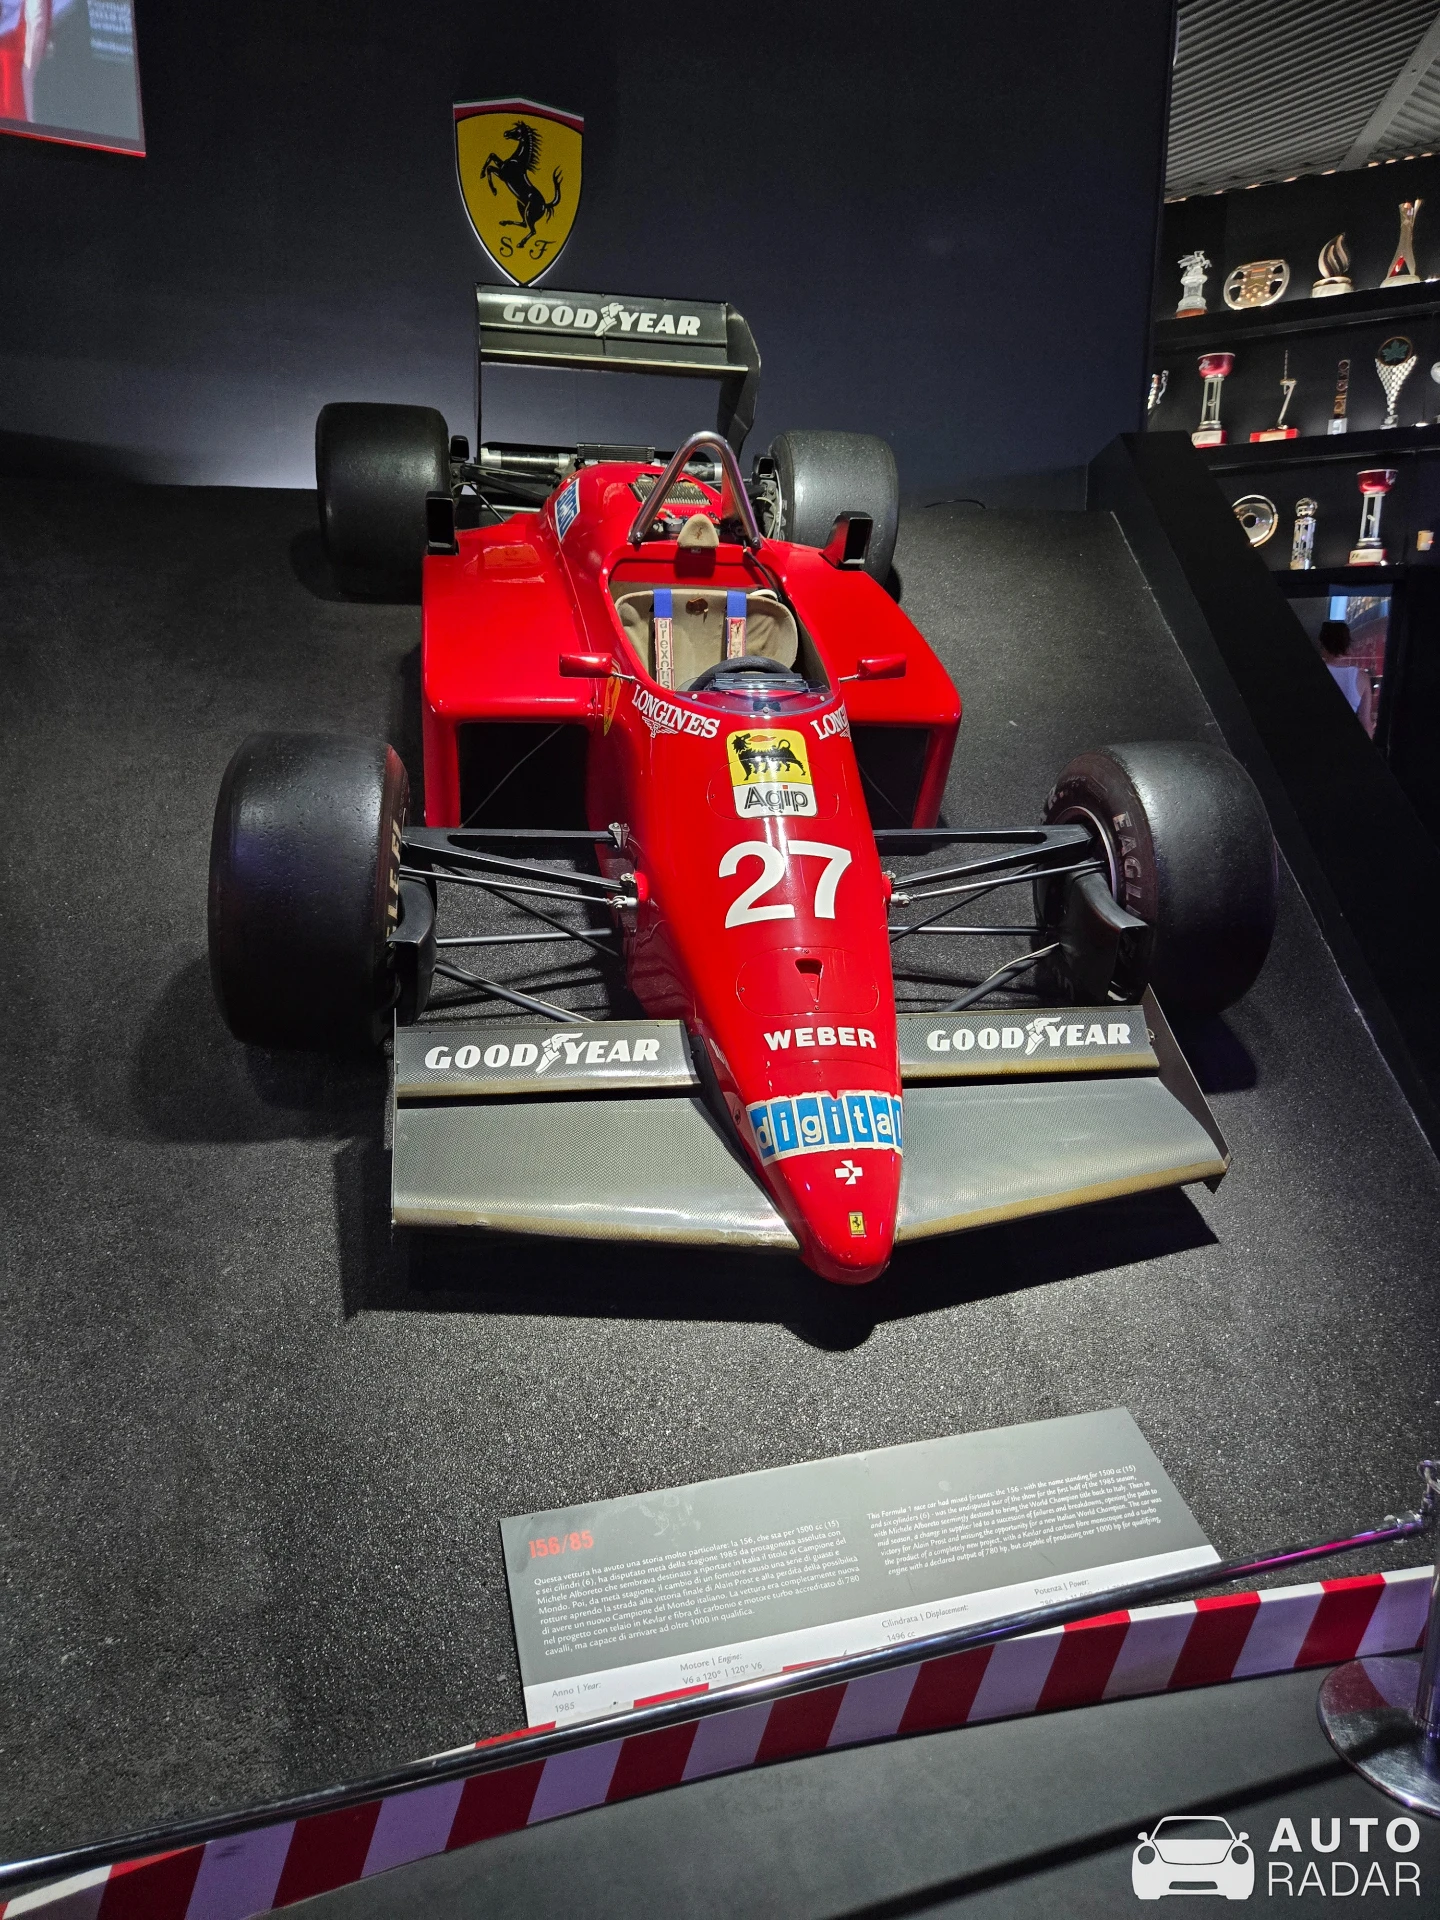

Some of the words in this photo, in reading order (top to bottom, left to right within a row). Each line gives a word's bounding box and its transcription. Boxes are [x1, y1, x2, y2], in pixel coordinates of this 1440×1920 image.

[500, 237, 515, 258] S
[529, 239, 556, 260] F
[632, 684, 720, 739] LONGINES
[743, 784, 810, 814] Agip
[718, 839, 852, 929] 27
[1113, 811, 1143, 915] EAGL
[763, 1027, 877, 1051] WEBER
[755, 1103, 901, 1150] digital
[529, 1530, 594, 1559] 156/85
[533, 1575, 563, 1586] Questa
[563, 1570, 591, 1580] vettura
[591, 1567, 602, 1575] ha
[603, 1563, 625, 1573] avuto
[626, 1560, 641, 1568] una
[641, 1555, 664, 1565] storia
[664, 1551, 687, 1561] molto
[688, 1543, 730, 1558] particolare:
[739, 1536, 756, 1545] 156,
[756, 1534, 769, 1542] che
[770, 1532, 782, 1540] sta
[783, 1529, 795, 1539] per
[796, 1524, 814, 1534] 1500
[824, 1519, 840, 1530] (15)
[541, 1585, 553, 1594] sei
[553, 1580, 581, 1592] cilindri
[581, 1577, 597, 1588] (6),
[597, 1575, 609, 1583] ha
[609, 1569, 646, 1581] disputato
[647, 1564, 667, 1574] metà
[667, 1560, 686, 1570] della
[687, 1555, 718, 1566] stagione
[719, 1549, 738, 1559] 1985
[750, 1539, 796, 1555] protagonista
[797, 1533, 827, 1544] assoluta
[827, 1530, 841, 1538] con
[537, 1593, 567, 1605] Michele
[569, 1587, 603, 1599] Alboreto
[604, 1583, 618, 1592] che
[619, 1577, 656, 1589] sembrava
[656, 1570, 692, 1582] destinato
[699, 1562, 732, 1574] riportare
[741, 1556, 761, 1565] Italia
[767, 1549, 788, 1559] titolo
[797, 1541, 835, 1553] Campione
[835, 1536, 847, 1546] del
[538, 1603, 570, 1615] Mondo.
[571, 1599, 588, 1608] Poi,
[588, 1597, 600, 1605] da
[600, 1592, 621, 1603] metà
[621, 1587, 657, 1599] stagione,
[657, 1583, 663, 1592] il
[664, 1579, 693, 1590] cambio
[693, 1576, 702, 1584] di
[714, 1569, 747, 1580] fornitore
[747, 1563, 770, 1574] causò
[770, 1561, 785, 1569] una
[786, 1557, 803, 1566] serie
[803, 1554, 812, 1562] di
[812, 1551, 834, 1562] guasti
[540, 1614, 568, 1625] rotture
[569, 1606, 603, 1621] aprendo
[603, 1604, 612, 1613] la
[612, 1597, 638, 1611] strada
[639, 1597, 653, 1606] alla
[653, 1591, 682, 1603] vittoria
[682, 1586, 704, 1596] finale
[705, 1584, 713, 1592] di
[714, 1581, 734, 1590] Alain
[734, 1577, 754, 1586] Prost
[761, 1572, 775, 1581] alla
[776, 1566, 802, 1580] perdita
[803, 1561, 821, 1572] della
[821, 1555, 859, 1570] possibilità
[1033, 1585, 1063, 1596] Potenza
[1068, 1579, 1090, 1589] Power:
[541, 1626, 550, 1635] di
[551, 1624, 572, 1633] avere
[573, 1621, 585, 1629] un
[586, 1616, 611, 1626] nuovo
[612, 1608, 652, 1621] Campione
[653, 1603, 666, 1613] del
[666, 1598, 696, 1610] Mondo
[696, 1593, 728, 1604] italiano.
[728, 1590, 739, 1598] La
[739, 1585, 766, 1595] vettura
[767, 1582, 780, 1590] era
[780, 1571, 837, 1587] completamente
[837, 1566, 860, 1575] nuova
[543, 1635, 556, 1646] nel
[557, 1631, 592, 1645] progetto
[593, 1627, 608, 1636] con
[609, 1621, 632, 1632] telaio
[642, 1615, 667, 1626] Kevlar
[673, 1610, 692, 1619] fibra
[693, 1606, 702, 1615] di
[702, 1601, 737, 1613] carbonio
[744, 1594, 771, 1605] motore
[772, 1589, 794, 1599] turbo
[795, 1581, 836, 1595] accreditato
[836, 1577, 845, 1586] di
[844, 1574, 860, 1584] 780
[881, 1616, 919, 1628] Cilindrata
[925, 1604, 969, 1619] Displacement:
[544, 1644, 573, 1656] cavalli,
[574, 1642, 588, 1650] ma
[589, 1636, 617, 1648] capace
[618, 1632, 627, 1641] di
[628, 1628, 657, 1639] arrivare
[659, 1623, 670, 1633] ad
[670, 1621, 689, 1631] oltre
[690, 1616, 710, 1626] 1000
[711, 1614, 720, 1622] in
[720, 1608, 755, 1622] qualifica.
[886, 1631, 905, 1642] 1496
[907, 1630, 917, 1640] cc
[679, 1660, 710, 1672] Motore
[717, 1653, 742, 1665] Engine:
[682, 1675, 694, 1684] V6
[702, 1670, 721, 1680] 120°
[730, 1664, 749, 1675] 120°
[750, 1661, 763, 1670] V6
[551, 1688, 574, 1698] Anno
[582, 1682, 601, 1691] Year:
[555, 1701, 575, 1713] 1985
